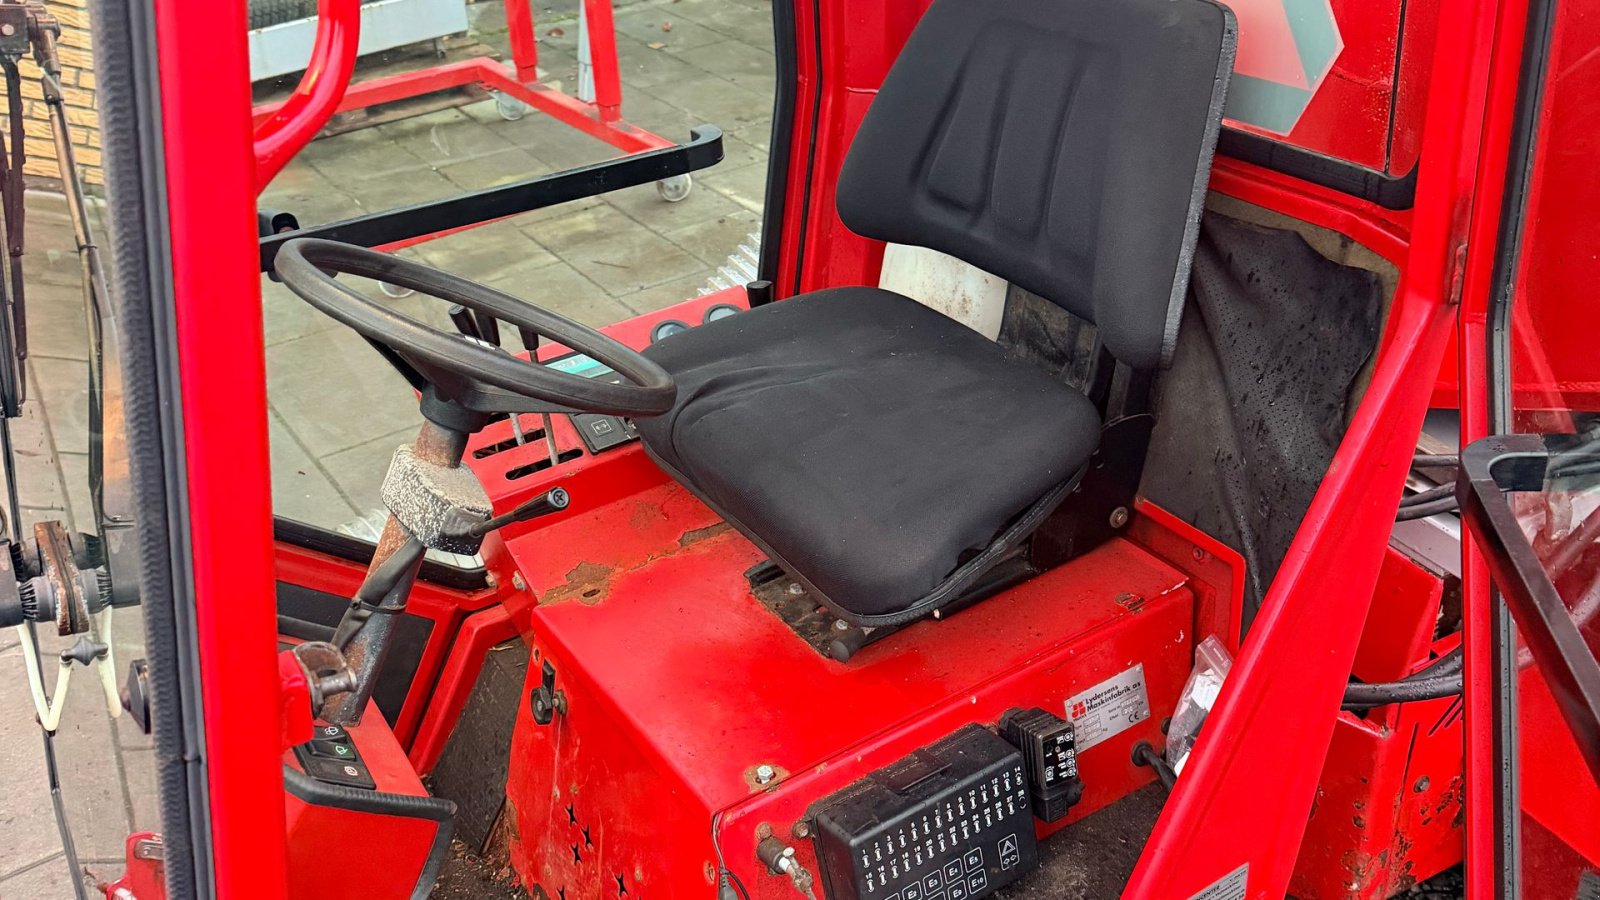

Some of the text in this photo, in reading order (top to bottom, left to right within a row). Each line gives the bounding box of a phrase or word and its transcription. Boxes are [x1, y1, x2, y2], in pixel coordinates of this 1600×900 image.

[1085, 685, 1119, 705] Lydersens
[1087, 686, 1131, 712] Maskinfabrik
[1128, 711, 1140, 723] CE
[908, 890, 917, 900] E2
[928, 879, 938, 888] E3
[949, 868, 958, 876] E4
[972, 878, 983, 887] E10
